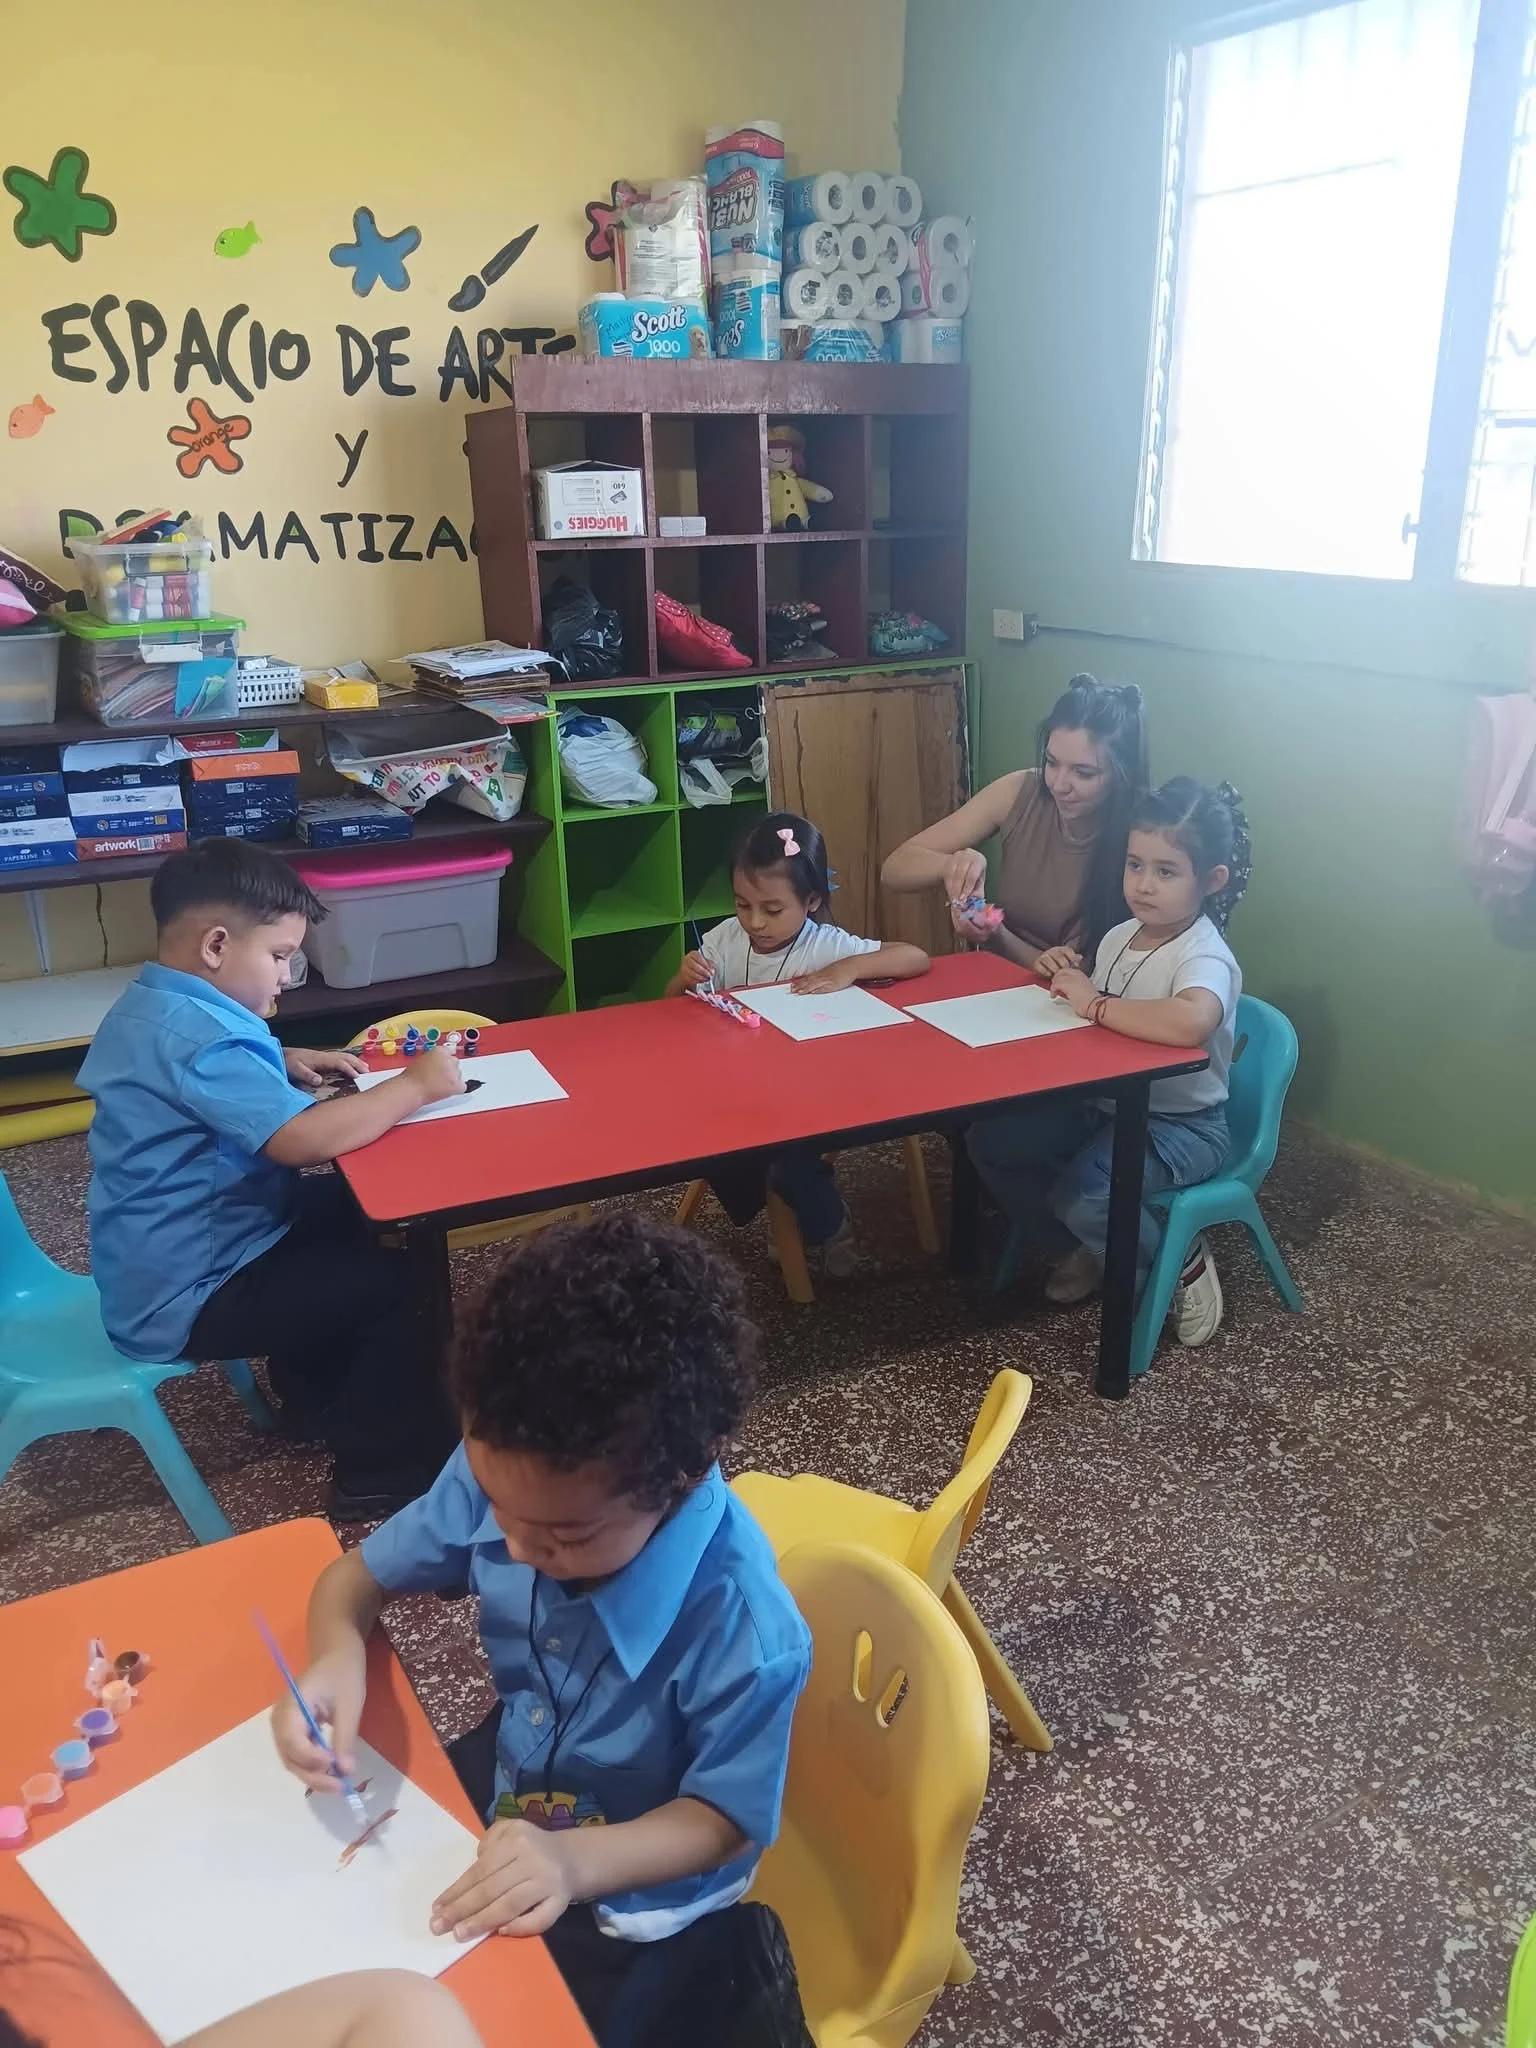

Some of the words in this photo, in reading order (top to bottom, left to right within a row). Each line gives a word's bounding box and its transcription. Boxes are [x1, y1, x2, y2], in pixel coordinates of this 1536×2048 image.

[631, 306, 686, 343] Scott
[41, 294, 311, 402] ESPACIO
[336, 324, 416, 396] DE
[438, 326, 577, 403] ART
[649, 340, 681, 354] 1000
[192, 424, 234, 452] orange
[59, 508, 479, 564] DMATIZA
[568, 516, 628, 532] HUGGIES
[95, 839, 137, 853] artwork
